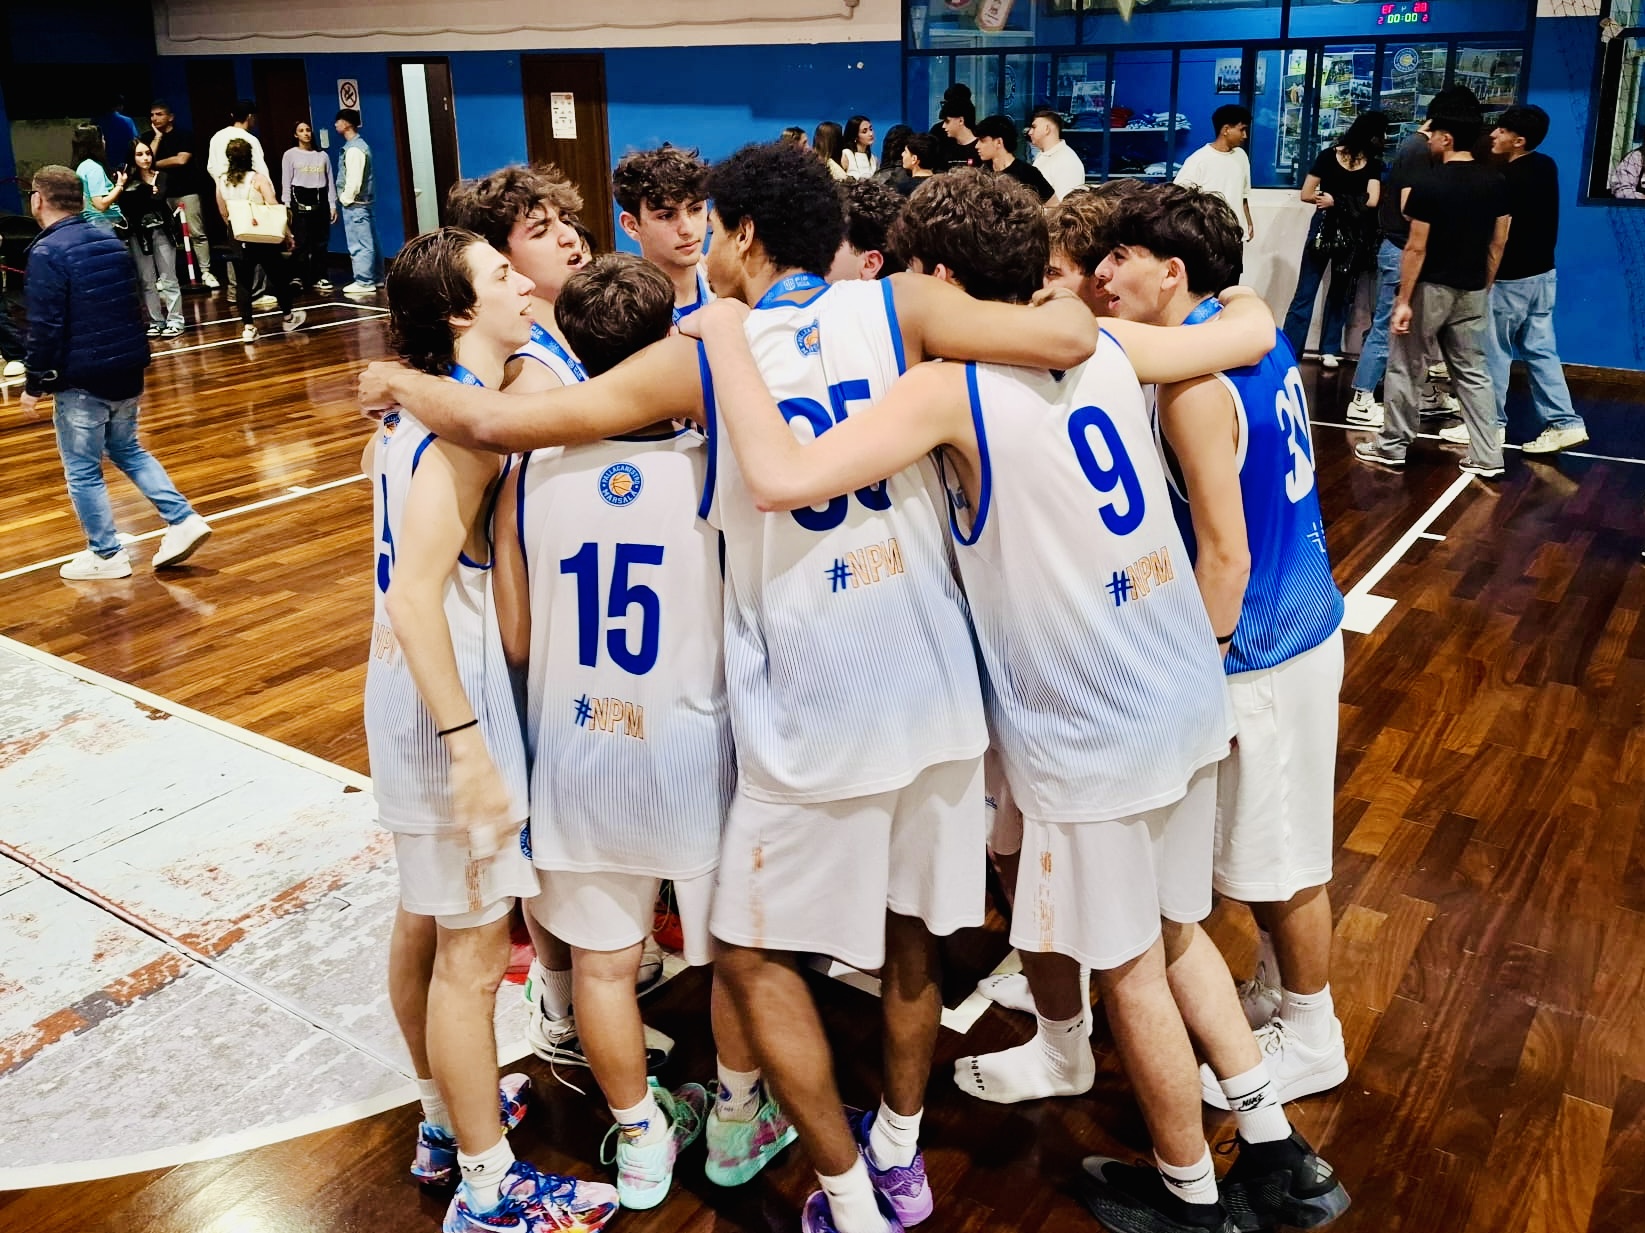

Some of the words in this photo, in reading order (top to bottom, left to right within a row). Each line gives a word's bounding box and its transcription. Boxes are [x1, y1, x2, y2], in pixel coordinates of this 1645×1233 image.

[602, 489, 638, 504] MARSALA
[1068, 405, 1145, 536] 9
[824, 538, 904, 593] #NPM
[1105, 546, 1174, 607] #NPM
[560, 542, 664, 676] 15
[574, 693, 644, 740] #NPM
[1242, 1092, 1264, 1107] NIKE
